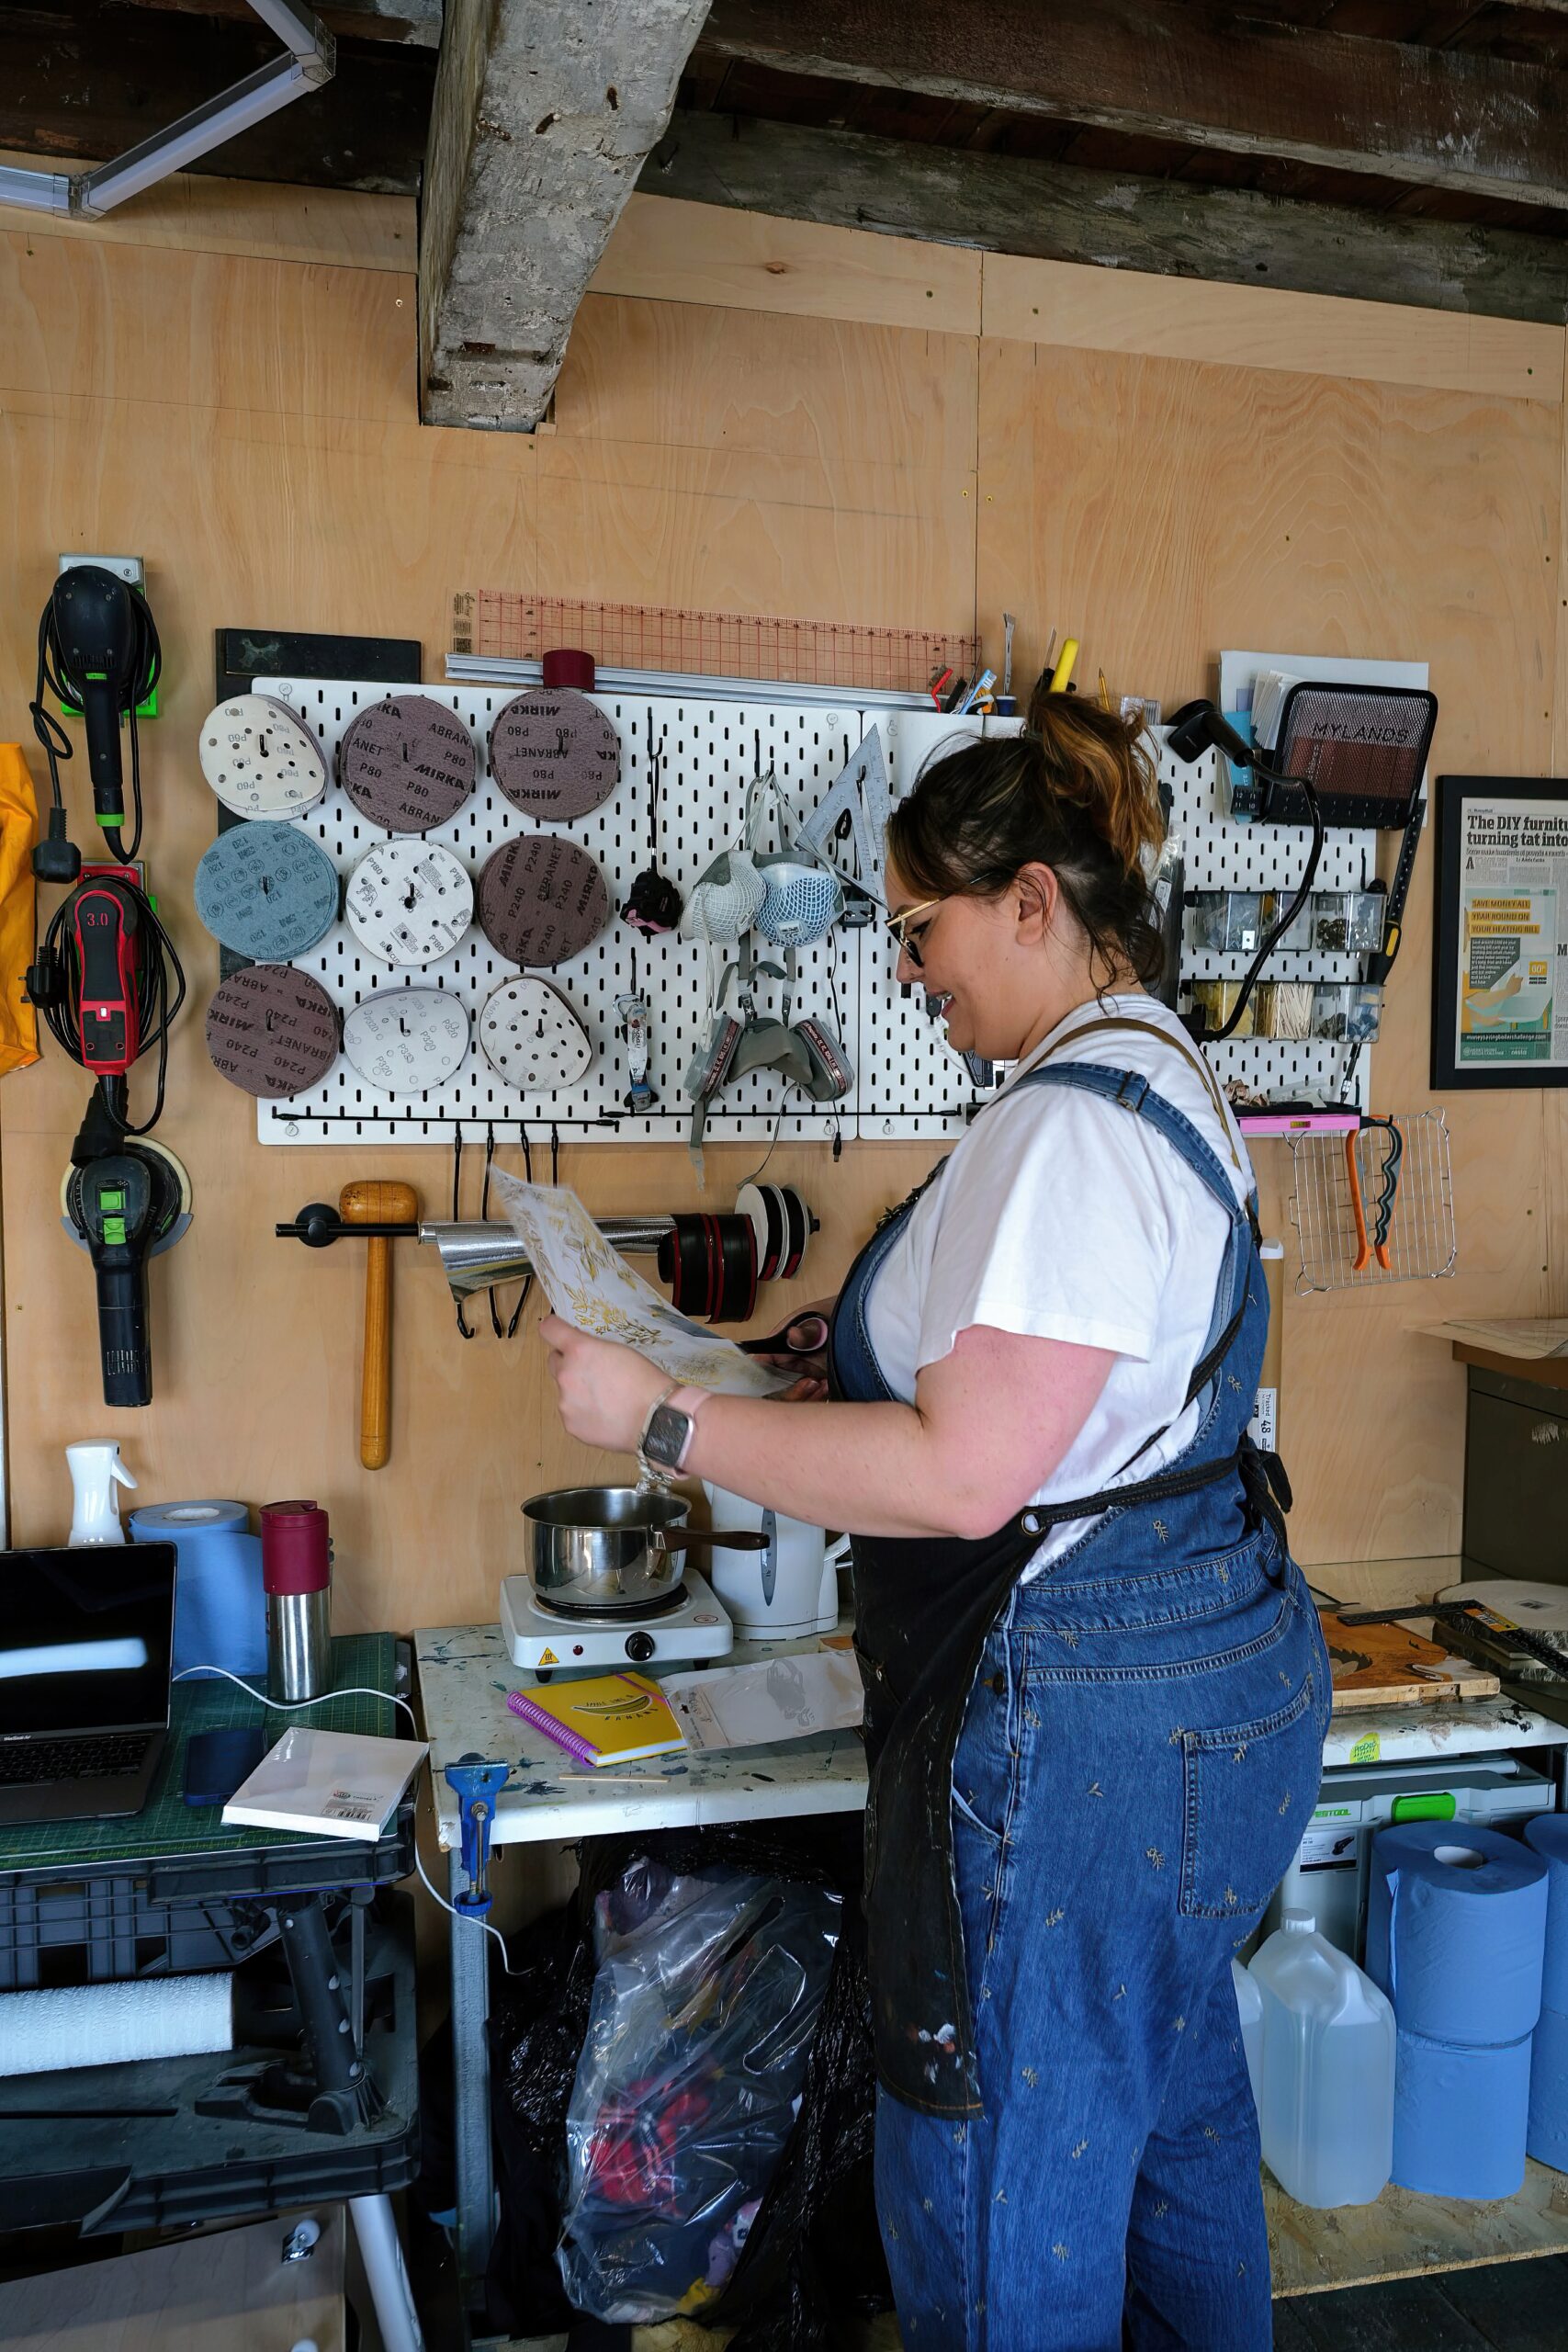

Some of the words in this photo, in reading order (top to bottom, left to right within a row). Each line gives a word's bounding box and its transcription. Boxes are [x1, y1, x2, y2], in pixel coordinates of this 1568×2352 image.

[224, 708, 243, 717] P0
[511, 705, 560, 717] MIRKA
[428, 722, 474, 749] ABRAN
[507, 726, 529, 737] P80
[1312, 722, 1409, 743] MYLANDS
[444, 751, 467, 767] P80
[515, 747, 569, 759] ABRANET
[360, 762, 382, 778] P80
[413, 763, 465, 791] MIRKA
[533, 769, 555, 780] P80
[285, 790, 303, 799] P0
[406, 781, 429, 797] P80
[508, 788, 561, 800] MIRKA
[1468, 816, 1495, 830] The
[1497, 816, 1521, 831] DIY
[1467, 831, 1519, 848] turning
[1521, 832, 1540, 846] tat
[1542, 832, 1568, 846] into
[367, 856, 383, 876] P180
[525, 842, 542, 873] P240
[449, 867, 466, 886] P180
[536, 844, 563, 902] ABRANET
[403, 876, 425, 900] BACUT
[555, 879, 573, 910] P240
[508, 887, 525, 919] P240
[1472, 899, 1488, 908] SAVE
[1491, 899, 1515, 908] MONEY
[87, 912, 108, 926] 3.0
[1472, 912, 1490, 921] YEAR
[428, 934, 445, 952] P180
[537, 924, 556, 956] P240
[218, 990, 250, 1010] P240
[265, 1008, 298, 1027] P240
[442, 1019, 458, 1039] P320
[226, 1039, 259, 1058] P240
[420, 1030, 436, 1052] P320
[274, 1057, 306, 1075] P240
[376, 1056, 393, 1077] P320
[1261, 1419, 1271, 1433] 48
